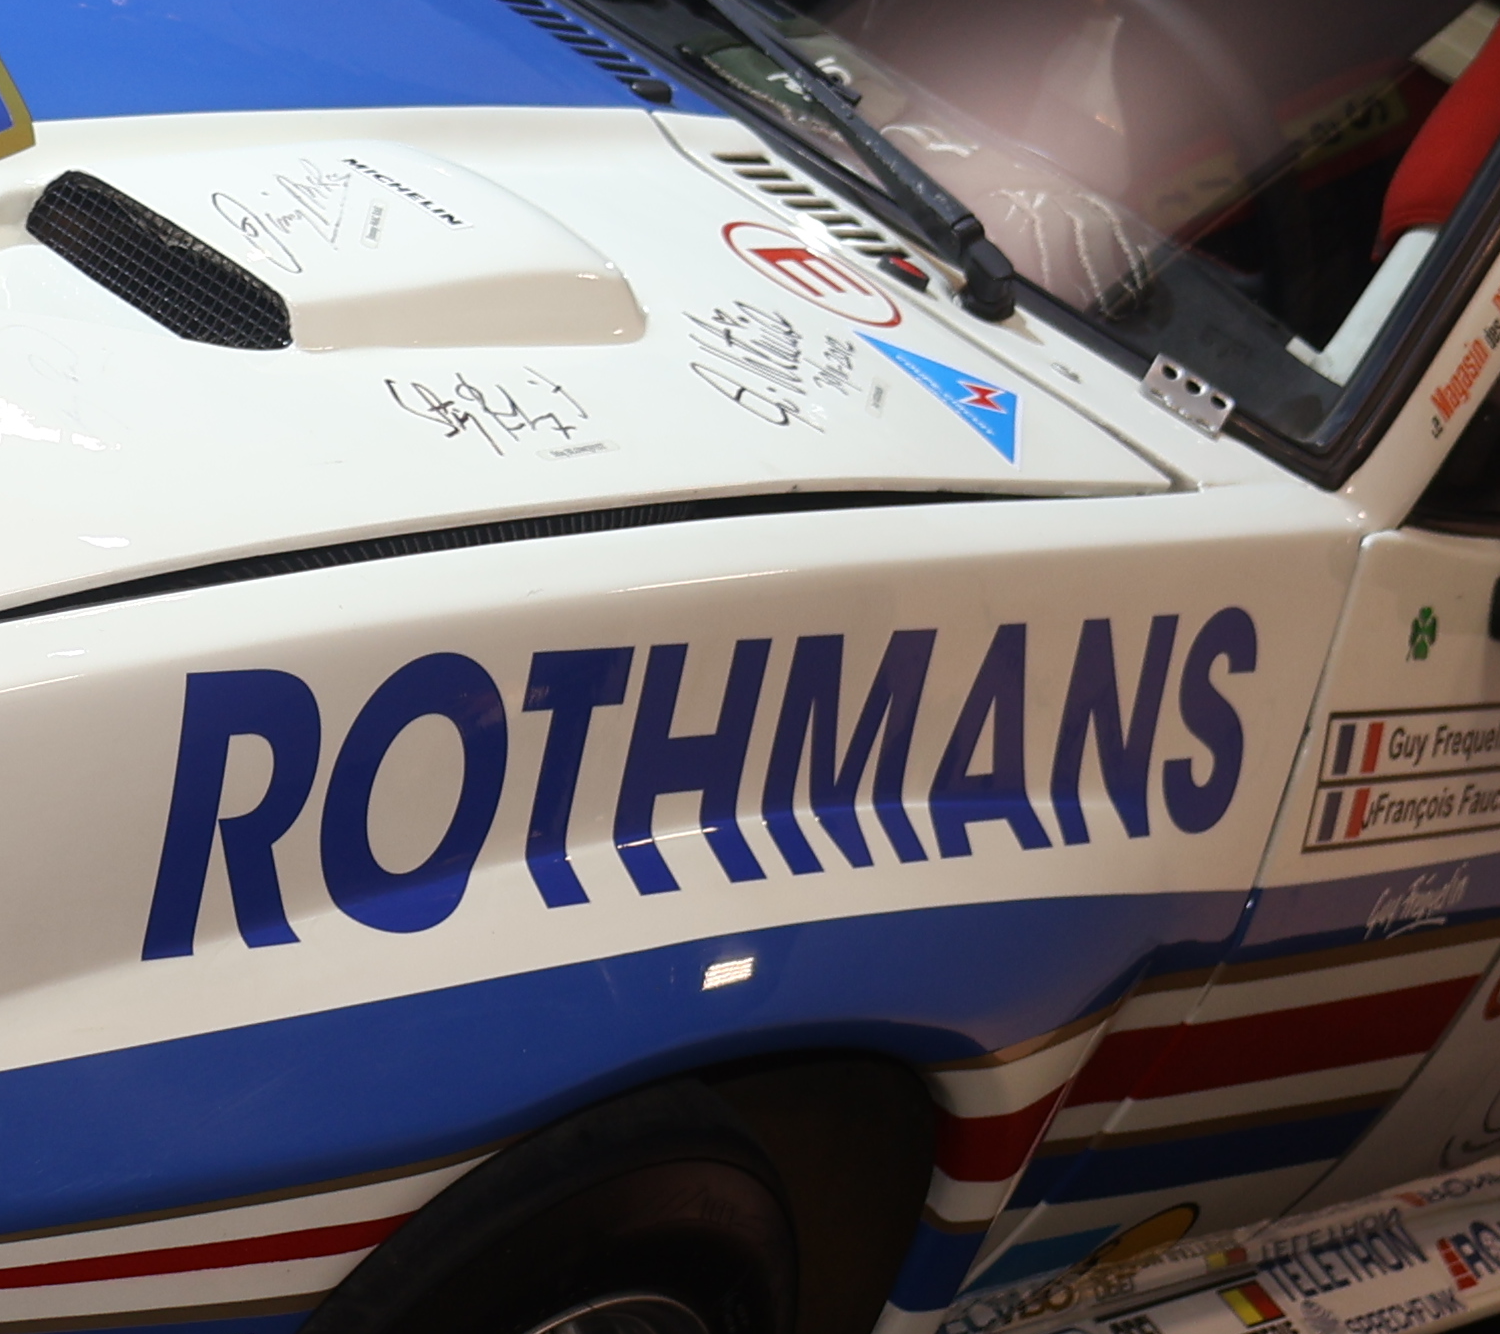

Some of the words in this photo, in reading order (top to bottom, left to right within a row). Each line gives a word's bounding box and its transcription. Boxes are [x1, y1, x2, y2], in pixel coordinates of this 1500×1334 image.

[342, 158, 463, 226] MICHELIN
[1430, 338, 1490, 423] Magasin
[141, 605, 1260, 961] ROTHMANS
[1388, 727, 1428, 766] Guy
[1257, 1229, 1428, 1302] TELETRON
